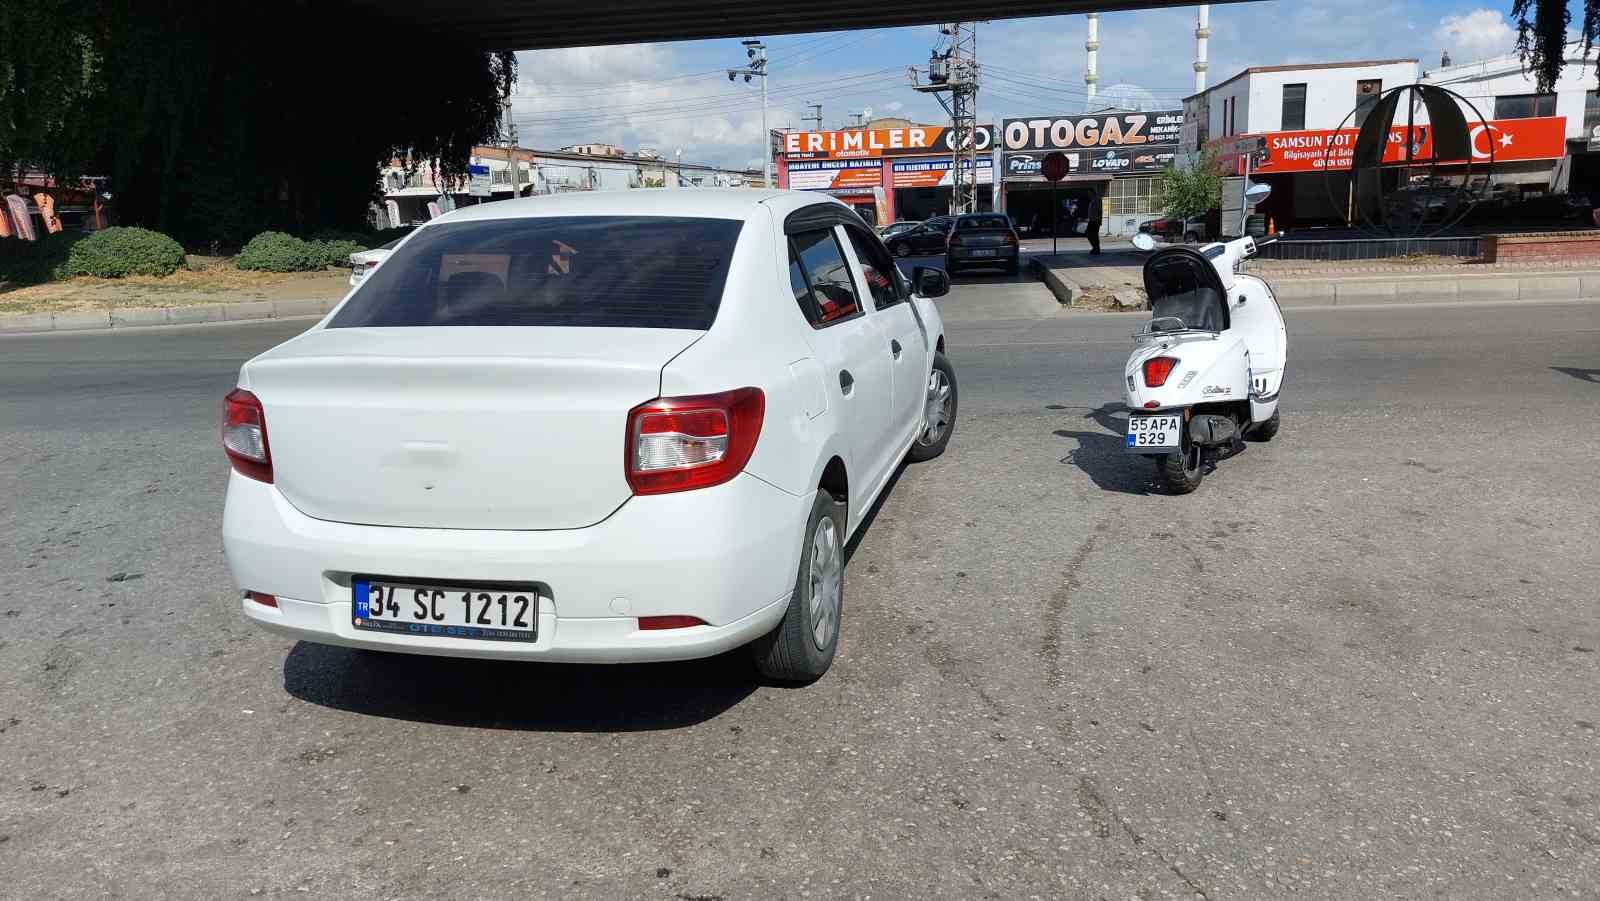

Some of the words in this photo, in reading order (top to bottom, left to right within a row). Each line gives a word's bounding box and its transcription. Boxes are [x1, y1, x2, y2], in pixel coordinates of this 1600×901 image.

[1005, 115, 1147, 149] OTOGAZ
[1273, 136, 1322, 149] SAMSUN
[1092, 158, 1130, 168] LOVATO
[1131, 419, 1148, 431] 55
[1150, 419, 1177, 431] APA
[1138, 432, 1166, 445] 529
[358, 602, 369, 611] TR
[370, 585, 400, 618] 34
[413, 588, 446, 621] SC
[461, 592, 529, 628] 1212
